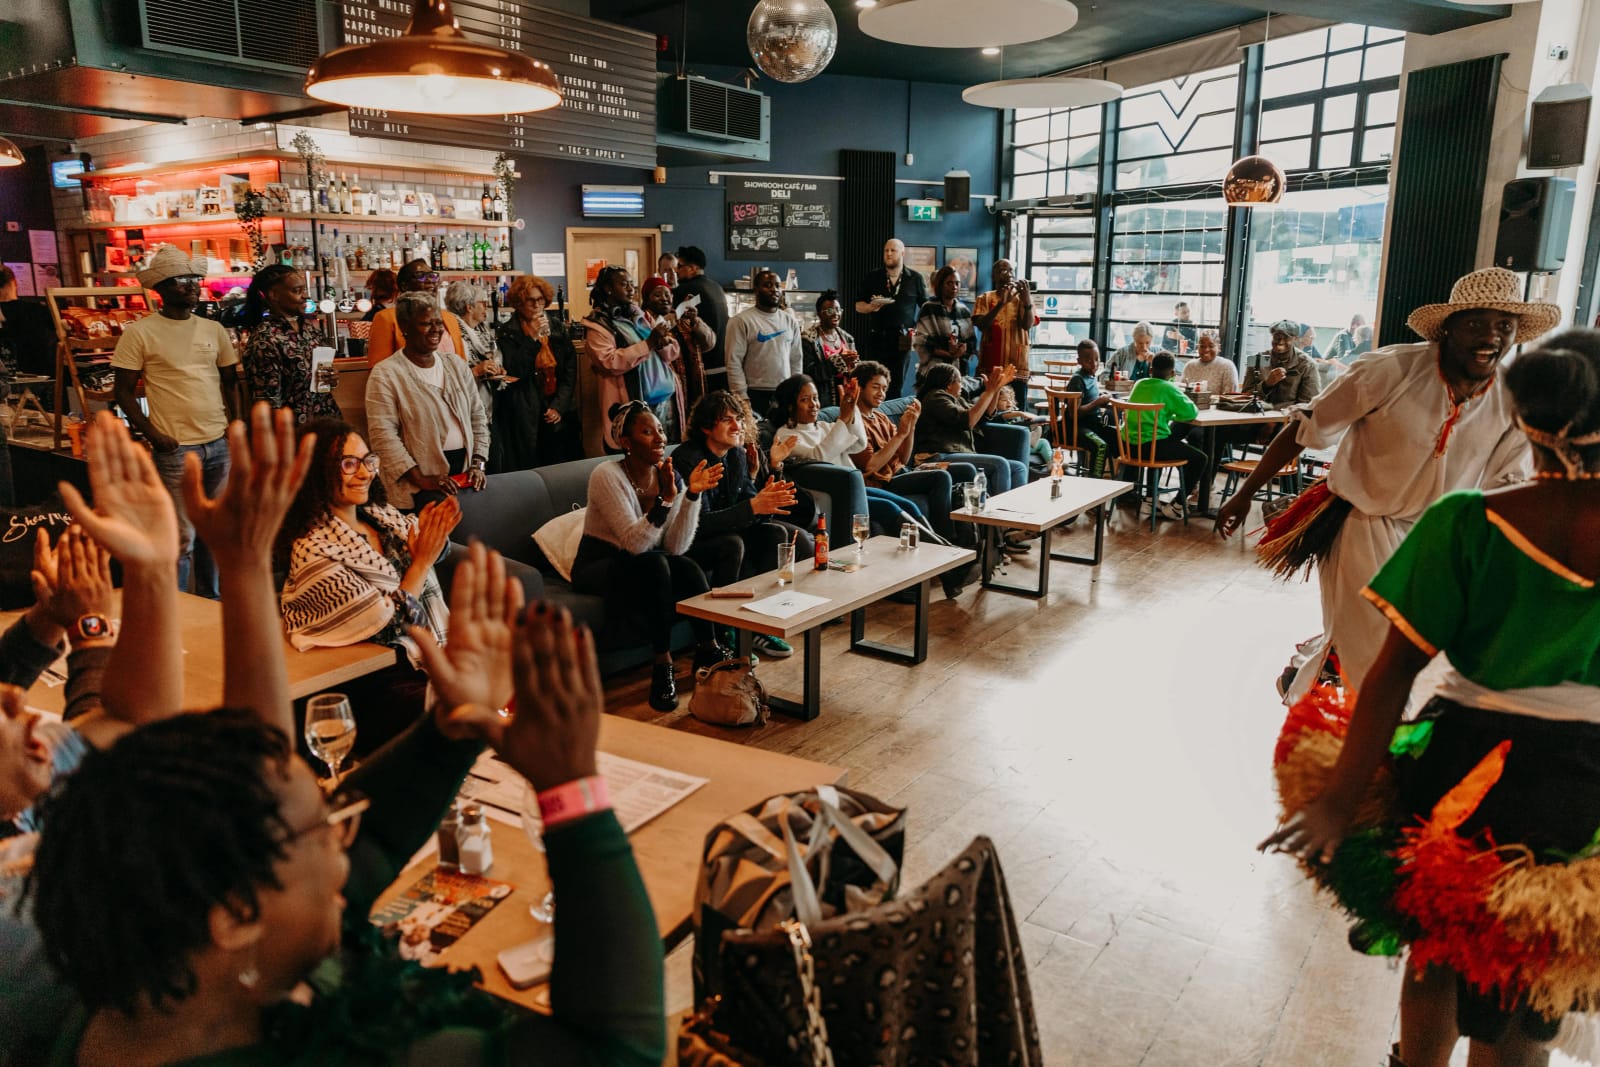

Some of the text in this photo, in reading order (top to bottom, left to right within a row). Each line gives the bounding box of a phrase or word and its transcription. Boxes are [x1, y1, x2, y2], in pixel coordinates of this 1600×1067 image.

[344, 4, 377, 20] LATTE
[344, 19, 403, 38] CAPPUCCIN
[569, 54, 607, 69] TAKE TWO
[563, 76, 596, 89] EVENING
[602, 84, 624, 94] MEALS
[562, 87, 626, 105] CINEMA TICKETS
[598, 105, 620, 116] HOUSE
[623, 109, 640, 119] WINE
[383, 123, 409, 134] MILK
[595, 149, 617, 159] APPLY
[744, 181, 784, 190] SHOWROOM
[771, 190, 791, 199] DELI
